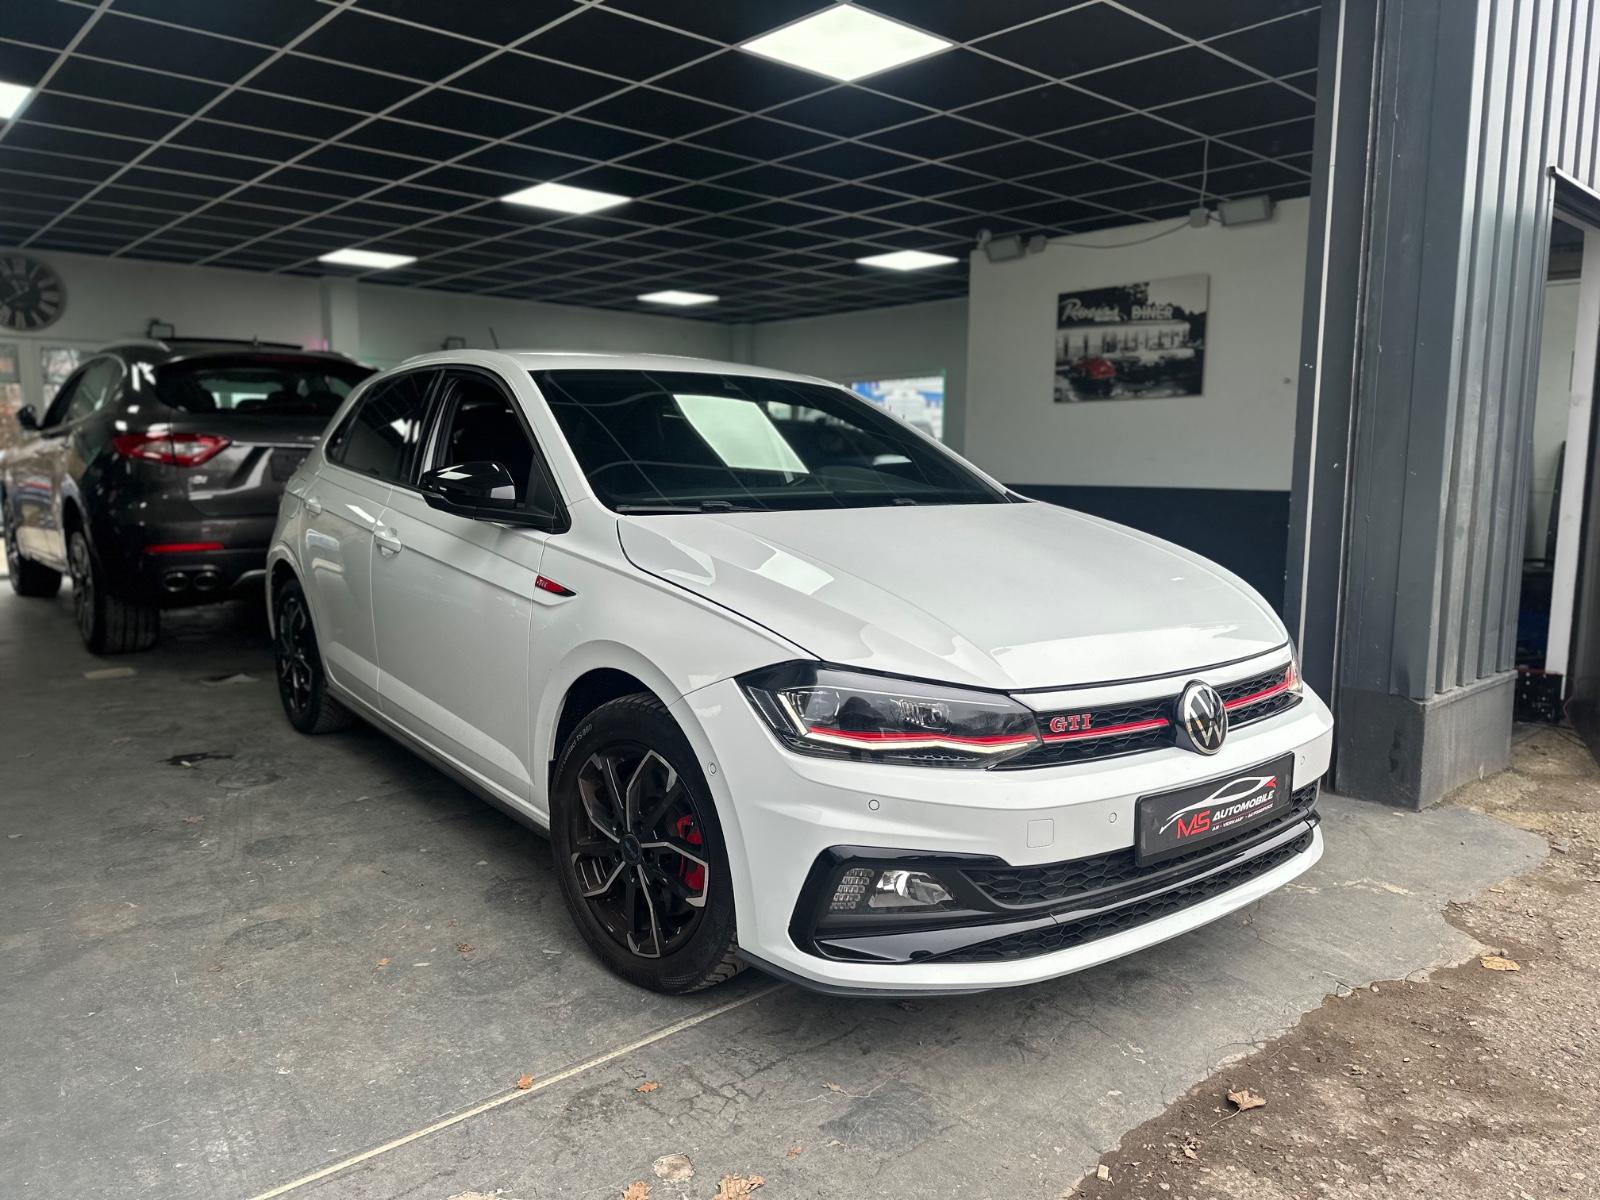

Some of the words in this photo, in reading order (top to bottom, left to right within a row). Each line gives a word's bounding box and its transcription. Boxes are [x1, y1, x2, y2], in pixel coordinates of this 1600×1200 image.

[1050, 713, 1091, 733] GTI
[1176, 809, 1211, 839] MS
[1212, 789, 1275, 821] AUTOMOBILE
